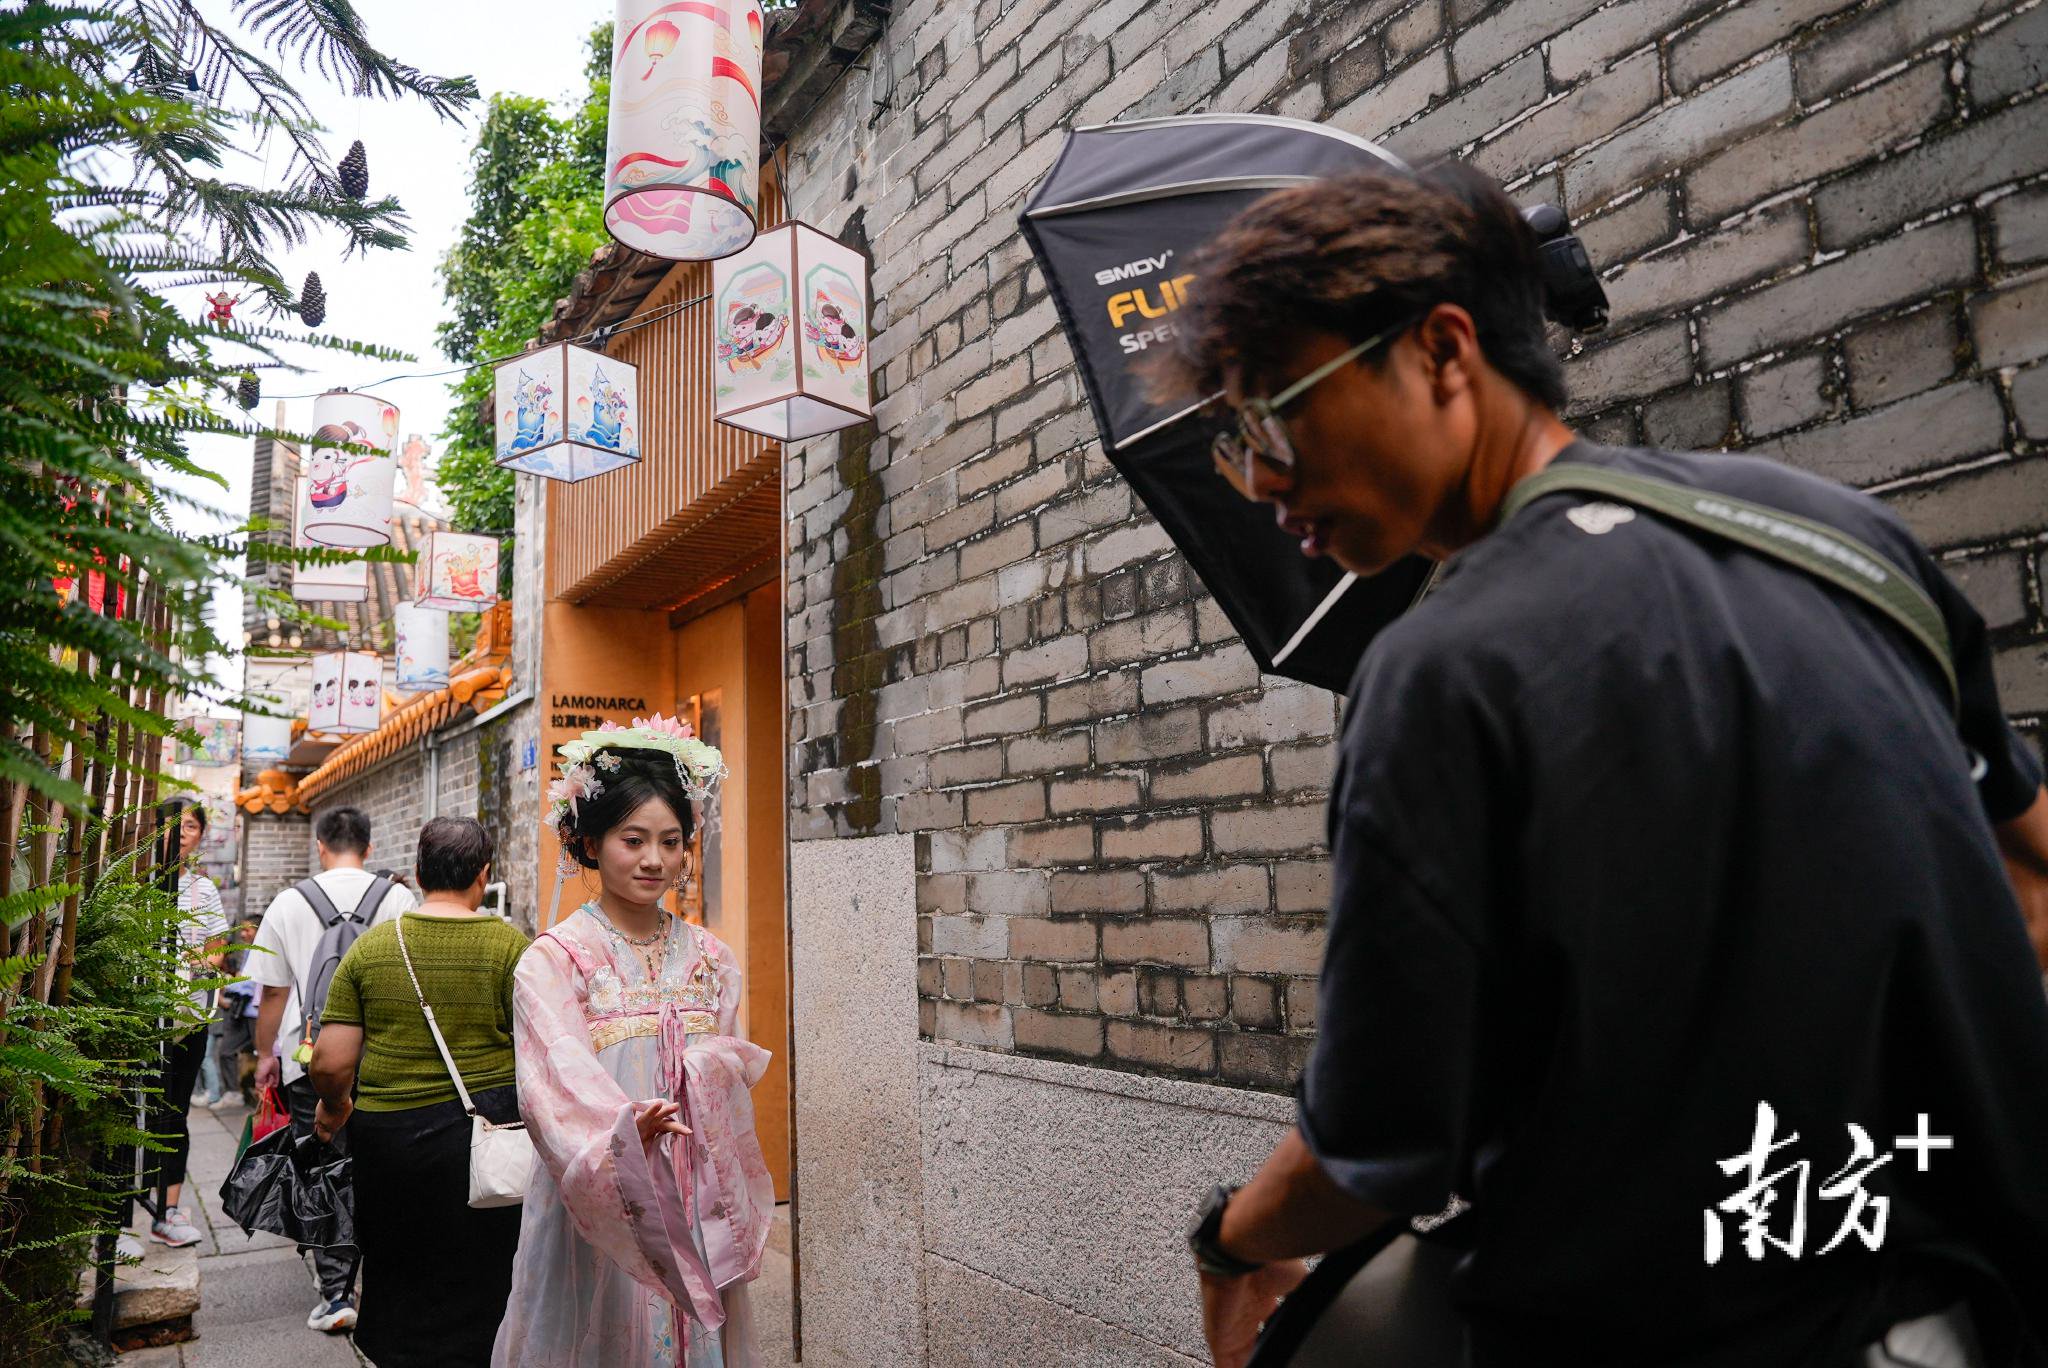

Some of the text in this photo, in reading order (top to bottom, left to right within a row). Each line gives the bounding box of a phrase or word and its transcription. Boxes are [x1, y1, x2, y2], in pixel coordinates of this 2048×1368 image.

[1094, 253, 1168, 286] SMDV
[1118, 320, 1181, 355] SPE
[552, 695, 645, 711] LAMONARCA
